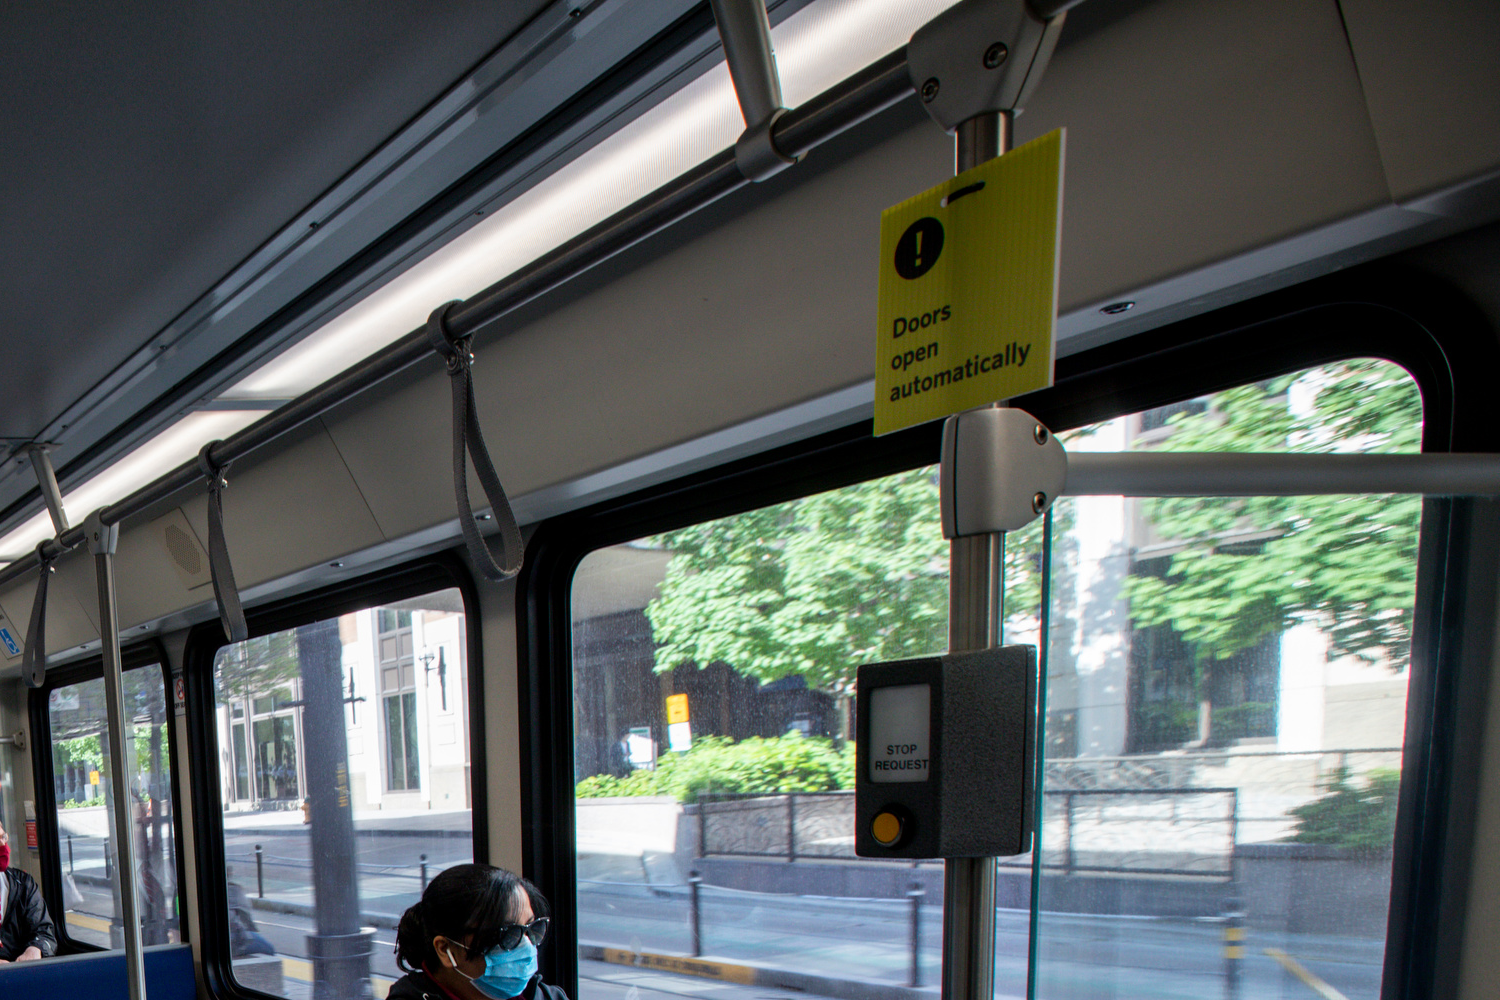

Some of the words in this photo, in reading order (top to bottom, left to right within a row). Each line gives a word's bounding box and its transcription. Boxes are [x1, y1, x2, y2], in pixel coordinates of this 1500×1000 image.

[892, 304, 952, 338] Doors
[891, 341, 938, 371] open
[890, 343, 1031, 402] automatically
[886, 744, 918, 755] STOP
[874, 760, 929, 771] REQUEST
